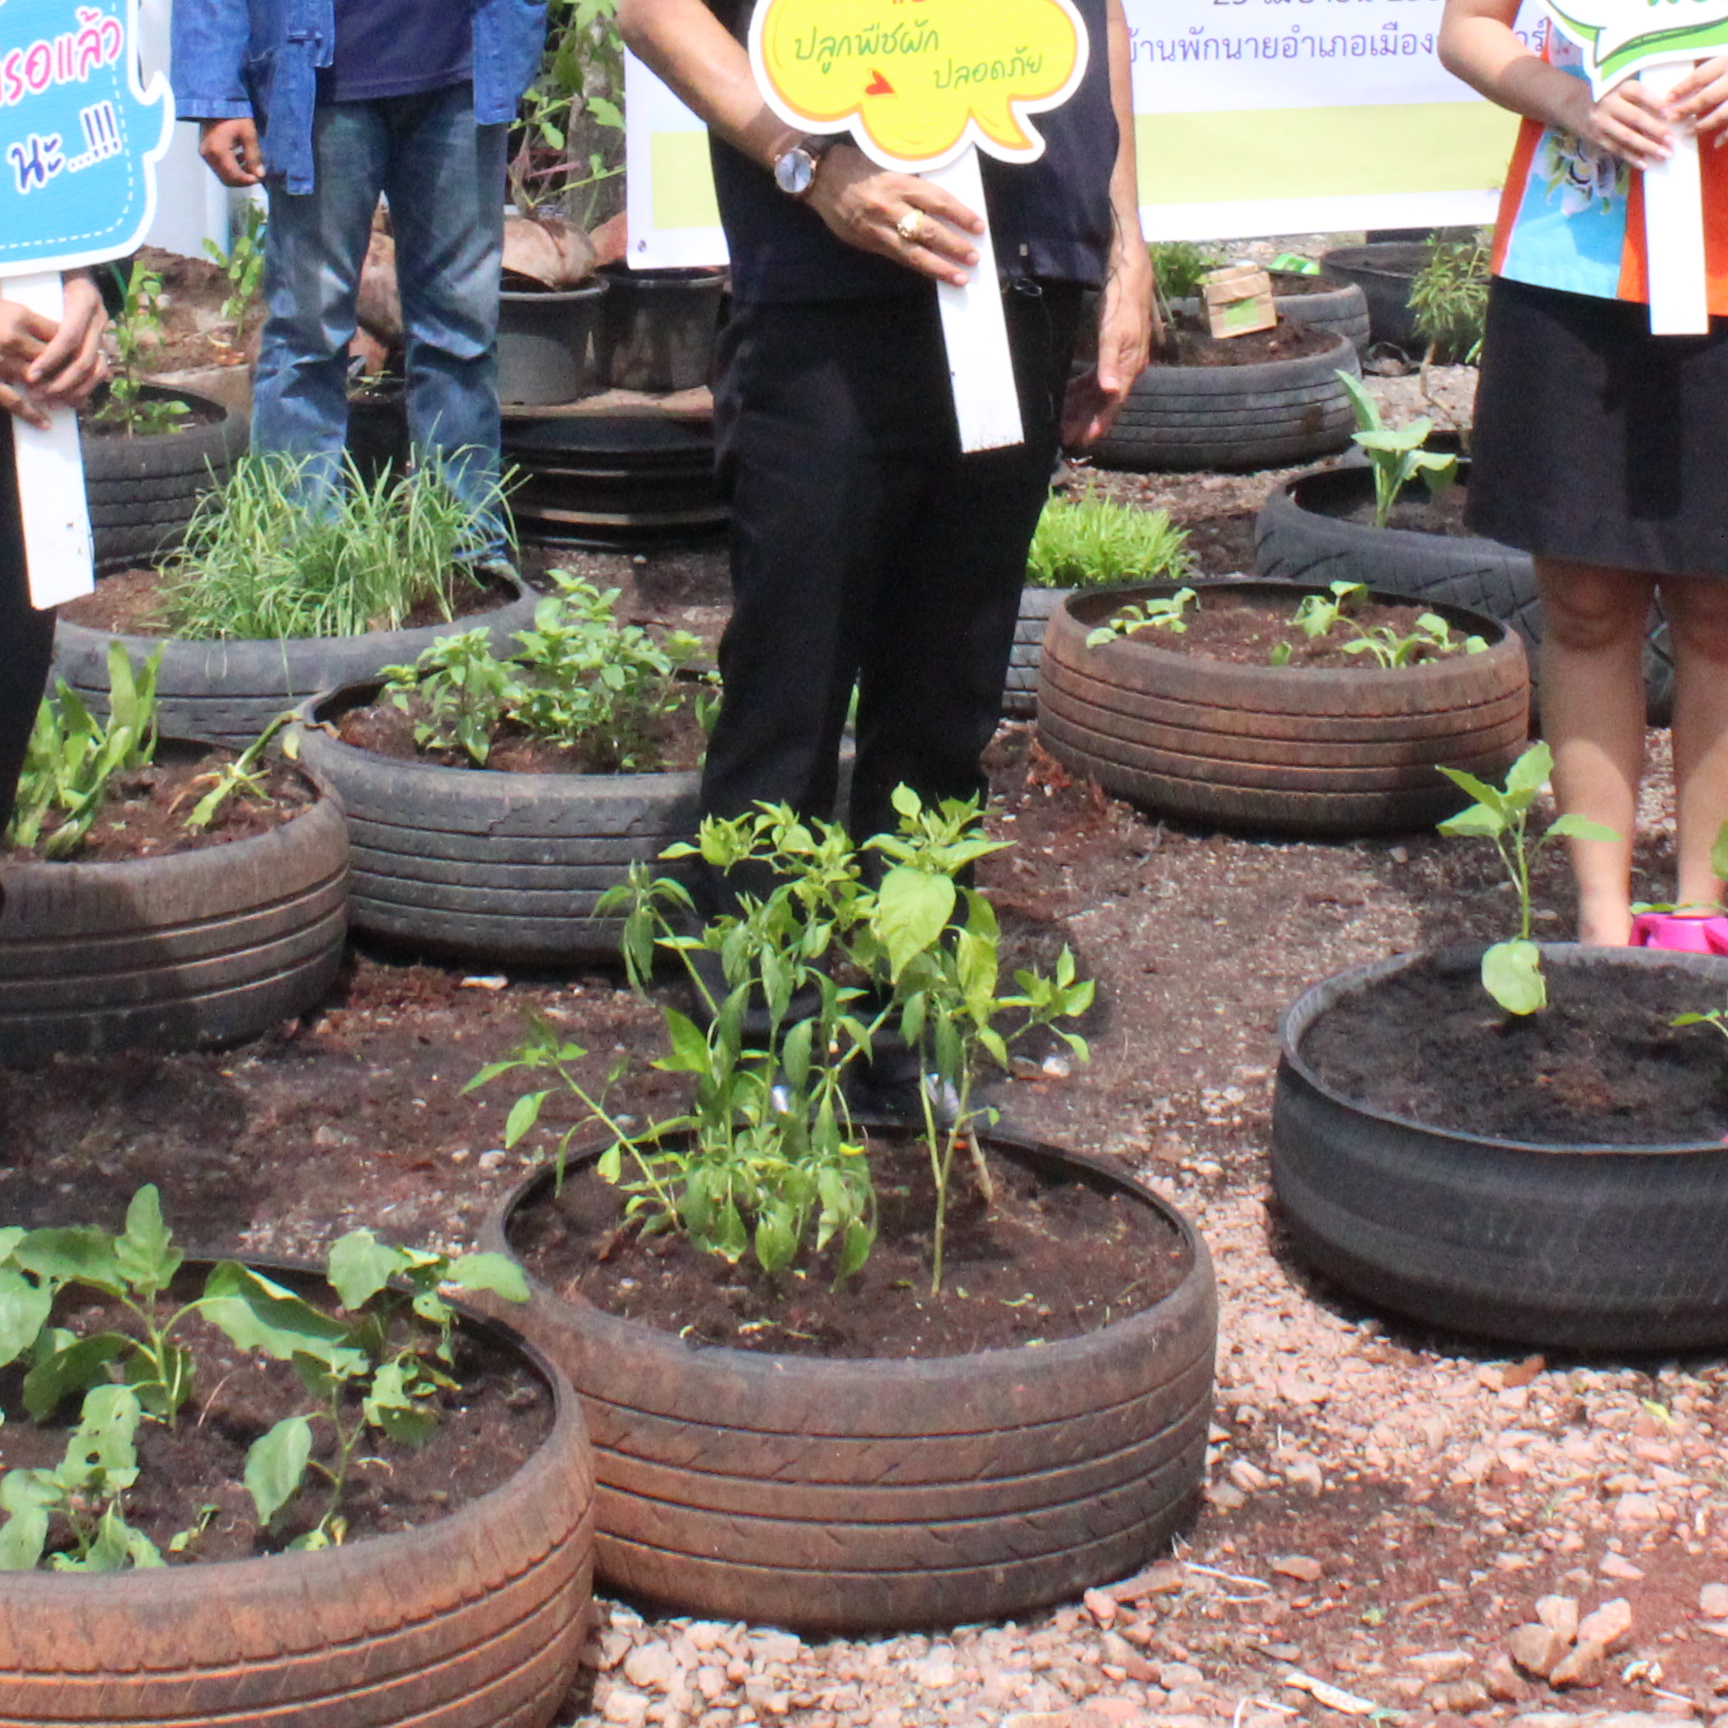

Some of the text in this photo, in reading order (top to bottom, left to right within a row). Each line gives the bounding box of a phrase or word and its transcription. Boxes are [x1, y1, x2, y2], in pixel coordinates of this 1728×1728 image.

[794, 19, 940, 74] ปลูกพืชผัก
[934, 46, 1043, 90] ปลอดภัย
